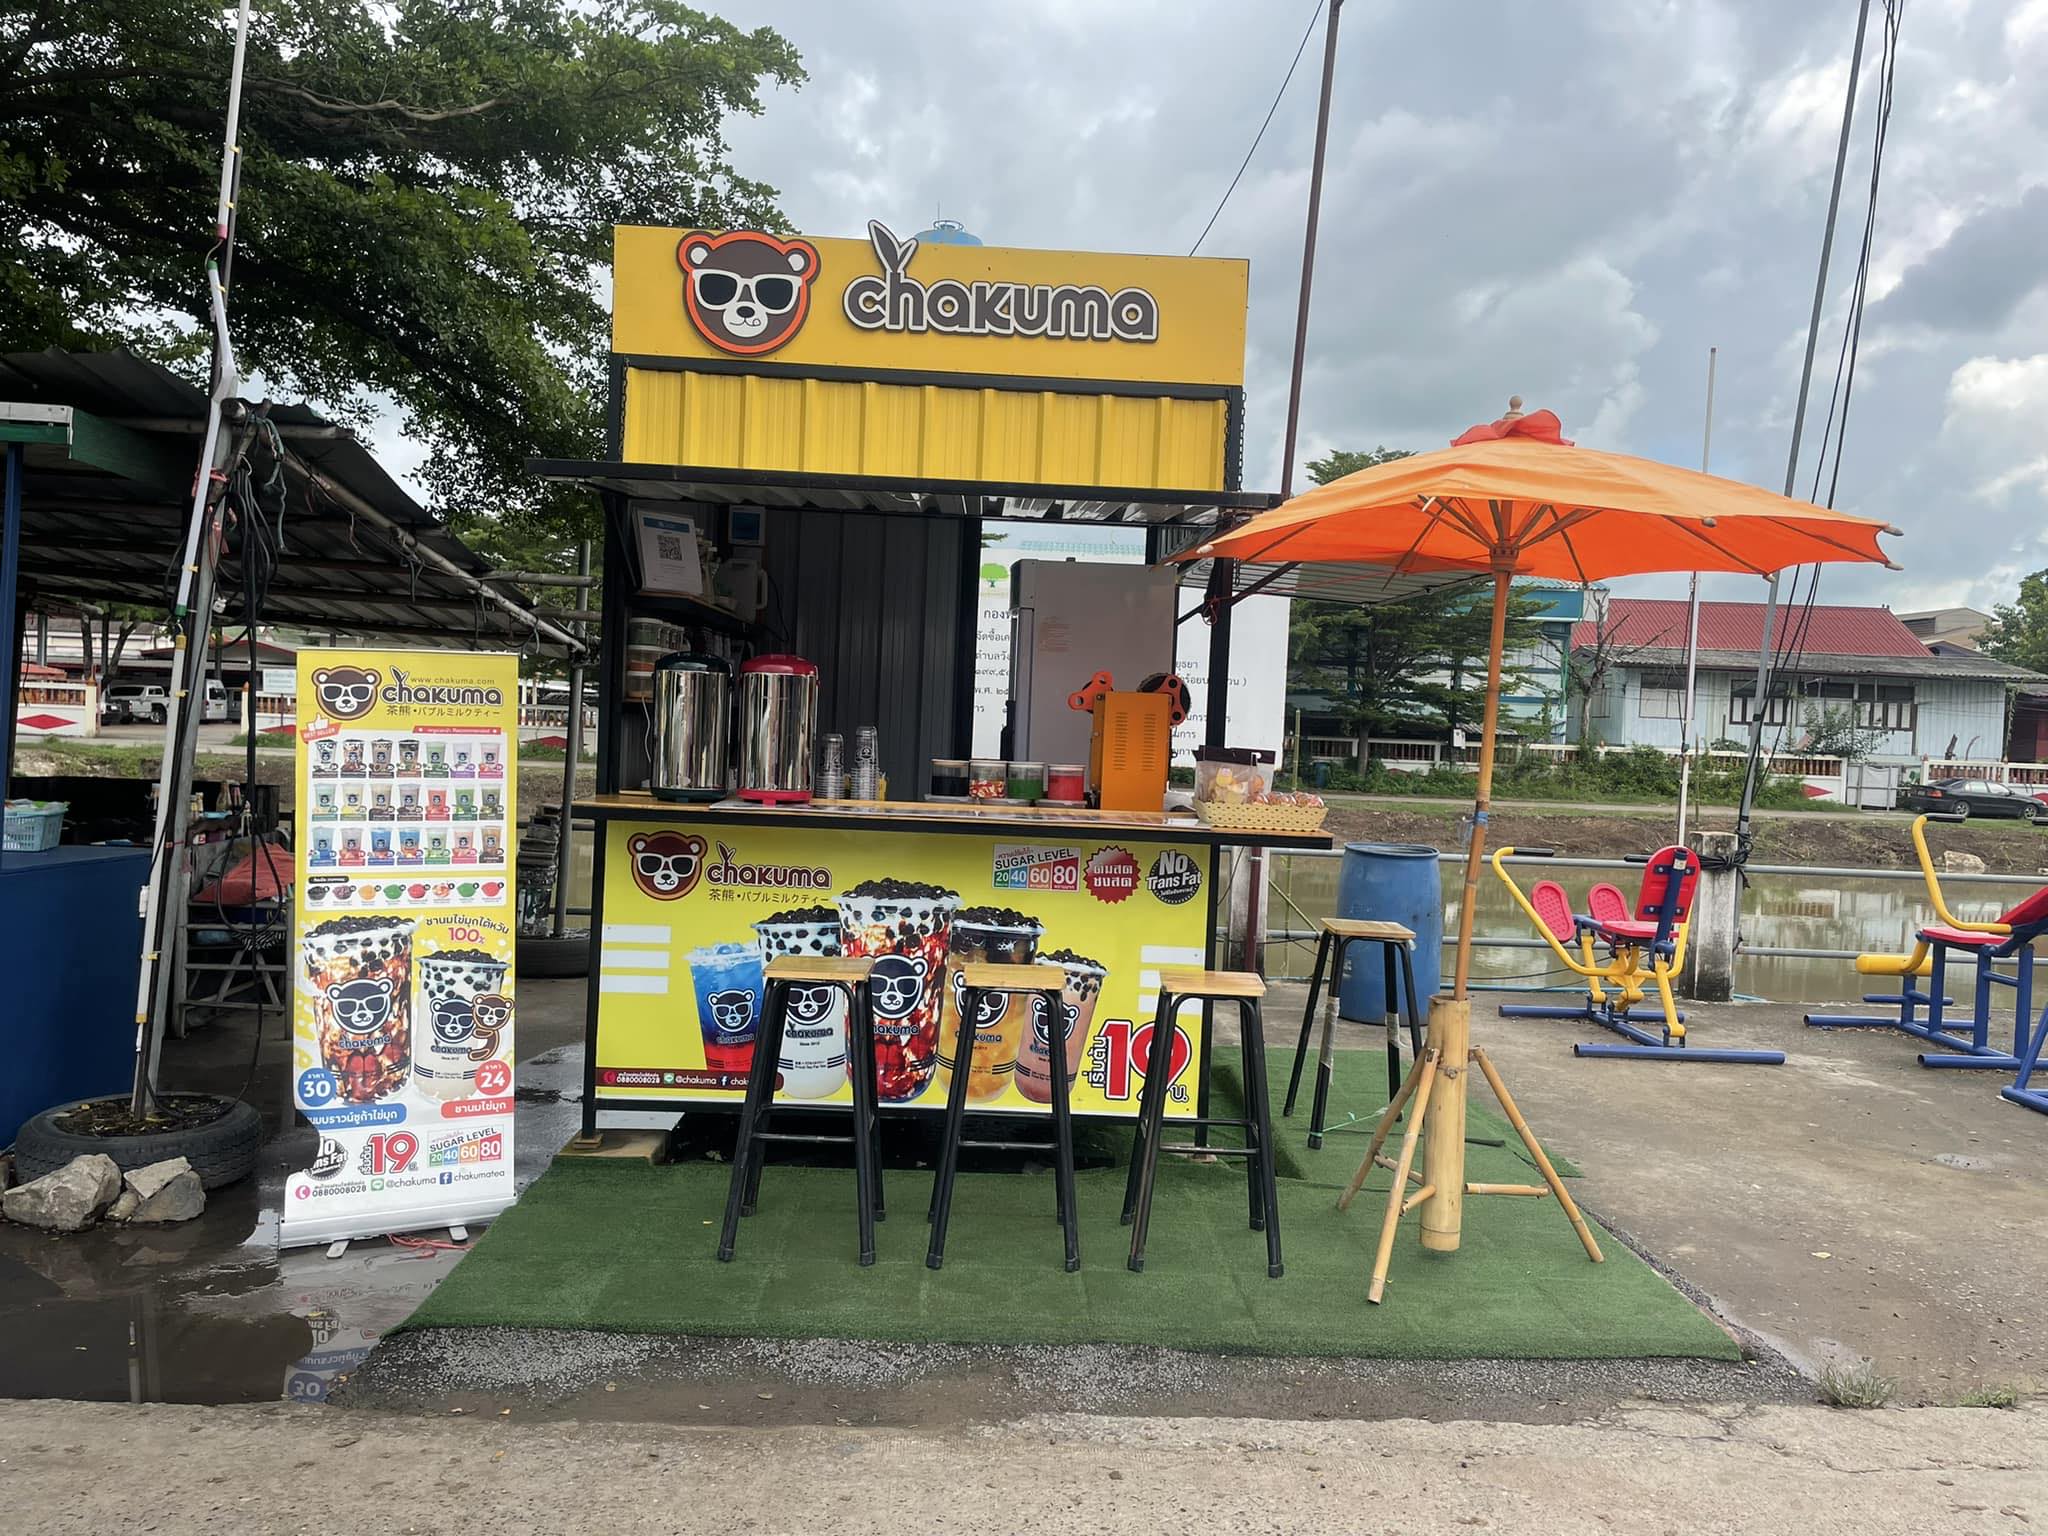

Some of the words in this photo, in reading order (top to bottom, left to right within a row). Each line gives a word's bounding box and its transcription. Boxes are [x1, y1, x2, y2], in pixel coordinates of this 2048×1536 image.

[842, 236, 1160, 341] chakuma
[381, 670, 503, 707] chakuma
[705, 848, 832, 889] chakuma
[995, 854, 1035, 871] SUGAR
[1037, 847, 1074, 862] LEVEL
[1159, 849, 1188, 876] No
[996, 870, 1009, 883] 20
[1011, 870, 1027, 883] 40
[1030, 868, 1050, 884] 60
[1053, 865, 1077, 885] 80
[1146, 873, 1181, 891] Trans
[1181, 870, 1202, 887] Fat
[448, 927, 486, 945] 100%
[785, 1025, 834, 1039] chakuma
[874, 1024, 921, 1035] akuma
[338, 1036, 392, 1049] chakuma
[303, 1081, 331, 1098] 30
[480, 1071, 506, 1089] 24
[616, 1076, 661, 1085] 0880008028
[675, 1074, 717, 1085] @chakuma
[454, 1100, 507, 1114] ชานมไข่มุก
[429, 1135, 465, 1153] SUGAR
[466, 1127, 497, 1142] LEVEL
[367, 1131, 419, 1175] 19
[431, 1153, 442, 1162] 20
[444, 1149, 458, 1161] 40
[460, 1145, 478, 1159] 60
[480, 1140, 501, 1157] 80
[312, 1184, 367, 1198] 0880008028
[386, 1176, 437, 1189] @chakuma
[453, 1169, 505, 1182] chakumatea
